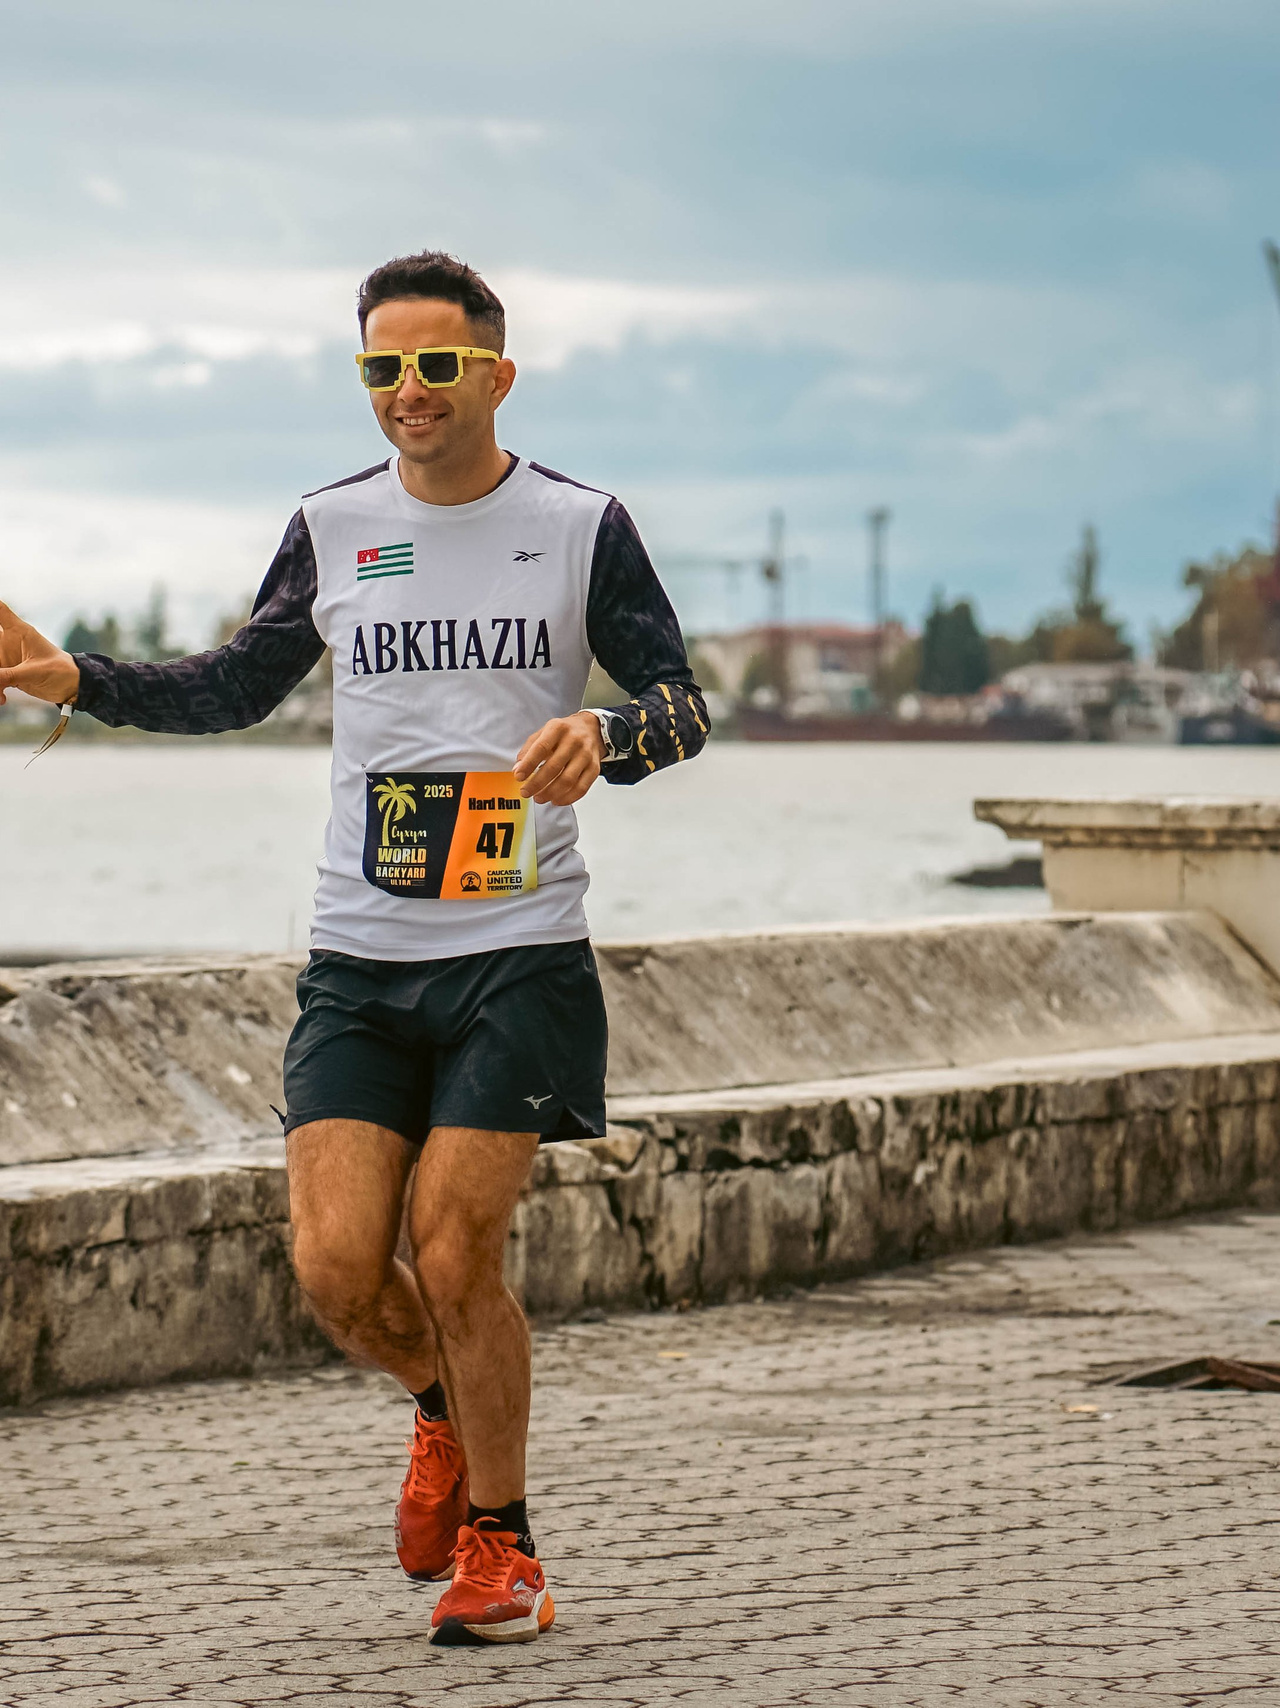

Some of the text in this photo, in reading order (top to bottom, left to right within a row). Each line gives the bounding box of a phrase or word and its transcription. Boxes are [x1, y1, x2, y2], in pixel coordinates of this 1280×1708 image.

[353, 618, 552, 675] ABKHAZIA
[424, 785, 454, 798] 2025
[468, 797, 522, 810] Hard Run
[476, 822, 515, 859] 47
[378, 848, 427, 864] WORLD
[375, 866, 426, 879] BACKYARD
[487, 876, 523, 885] UNITED
